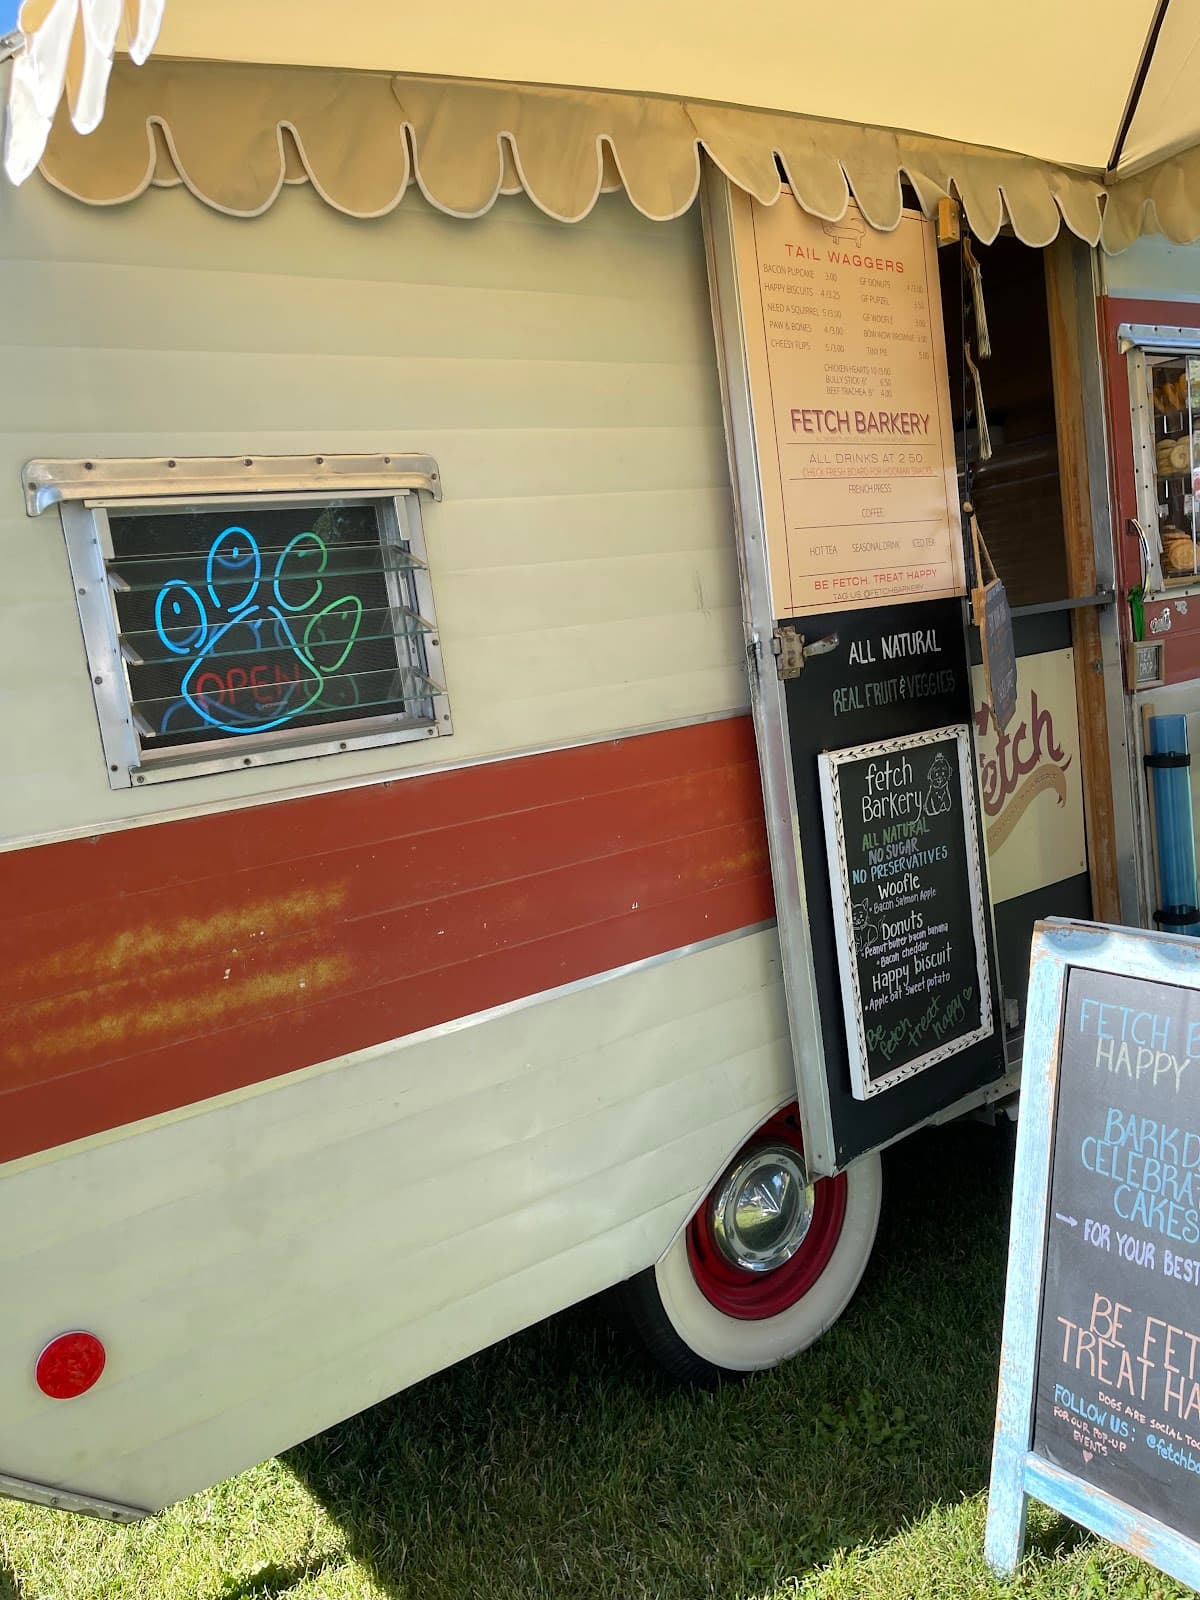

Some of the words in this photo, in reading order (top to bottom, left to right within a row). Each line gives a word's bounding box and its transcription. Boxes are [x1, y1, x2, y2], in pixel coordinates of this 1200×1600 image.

[763, 264, 786, 275] BACON
[785, 244, 820, 260] TAIL
[827, 250, 904, 273] WAGGERS
[790, 409, 850, 433] FETCH
[854, 411, 929, 435] BARKERY
[809, 453, 831, 464] ALL
[835, 453, 879, 464] DRINKS
[882, 453, 895, 463] AT
[849, 484, 873, 495] FRENCH
[874, 483, 892, 494] PRESS
[861, 507, 884, 518] COFFEE
[810, 546, 824, 557] HOT
[824, 545, 838, 555] TEA
[814, 580, 829, 590] BE
[873, 572, 904, 583] TREAT
[907, 569, 937, 580] HAPPY
[849, 639, 876, 665] ALL
[881, 629, 942, 660] NATURAL
[196, 663, 300, 707] OPEN
[833, 686, 864, 717] REAL
[864, 678, 898, 707] FRUIT
[906, 669, 956, 699] VEGGIES
[865, 755, 912, 795] fetch
[862, 791, 922, 825] Barkery
[862, 832, 880, 852] ALL
[882, 816, 931, 845] NATURAL
[868, 847, 884, 865] NO
[886, 837, 919, 860] SUGAR
[852, 868, 867, 885] NO
[870, 845, 948, 882] PRESERVATIVES
[873, 900, 894, 914] Bacon
[895, 893, 919, 907] Salmon
[919, 888, 937, 901] Apple
[878, 873, 920, 899] Woofle
[882, 910, 923, 941] Donuts
[927, 922, 949, 936] banana
[872, 965, 909, 993] Happy
[914, 942, 952, 974] biscuit
[880, 951, 900, 968] Bacon
[901, 942, 929, 958] cheddar
[869, 994, 889, 1012] Apple
[889, 986, 903, 1002] oat
[926, 970, 951, 992] potato
[1080, 998, 1170, 1052] FETCH
[1096, 1037, 1191, 1095] HAPPY
[1113, 1184, 1200, 1244] CAKES
[1084, 1218, 1110, 1252] FOR
[1116, 1231, 1156, 1270] YOUR
[1163, 1249, 1200, 1286] BEST
[1090, 1291, 1132, 1348] BE
[1057, 1316, 1155, 1401] TREAT
[1054, 1383, 1107, 1426] FOLLOW
[1098, 1391, 1122, 1412] DOGS
[1125, 1406, 1147, 1424] ARE
[1150, 1419, 1183, 1441] SOCIAL
[1053, 1406, 1070, 1423] FOR
[1071, 1416, 1090, 1434] OUR
[1093, 1427, 1127, 1453] POP-UP
[1073, 1430, 1109, 1457] EVENTS
